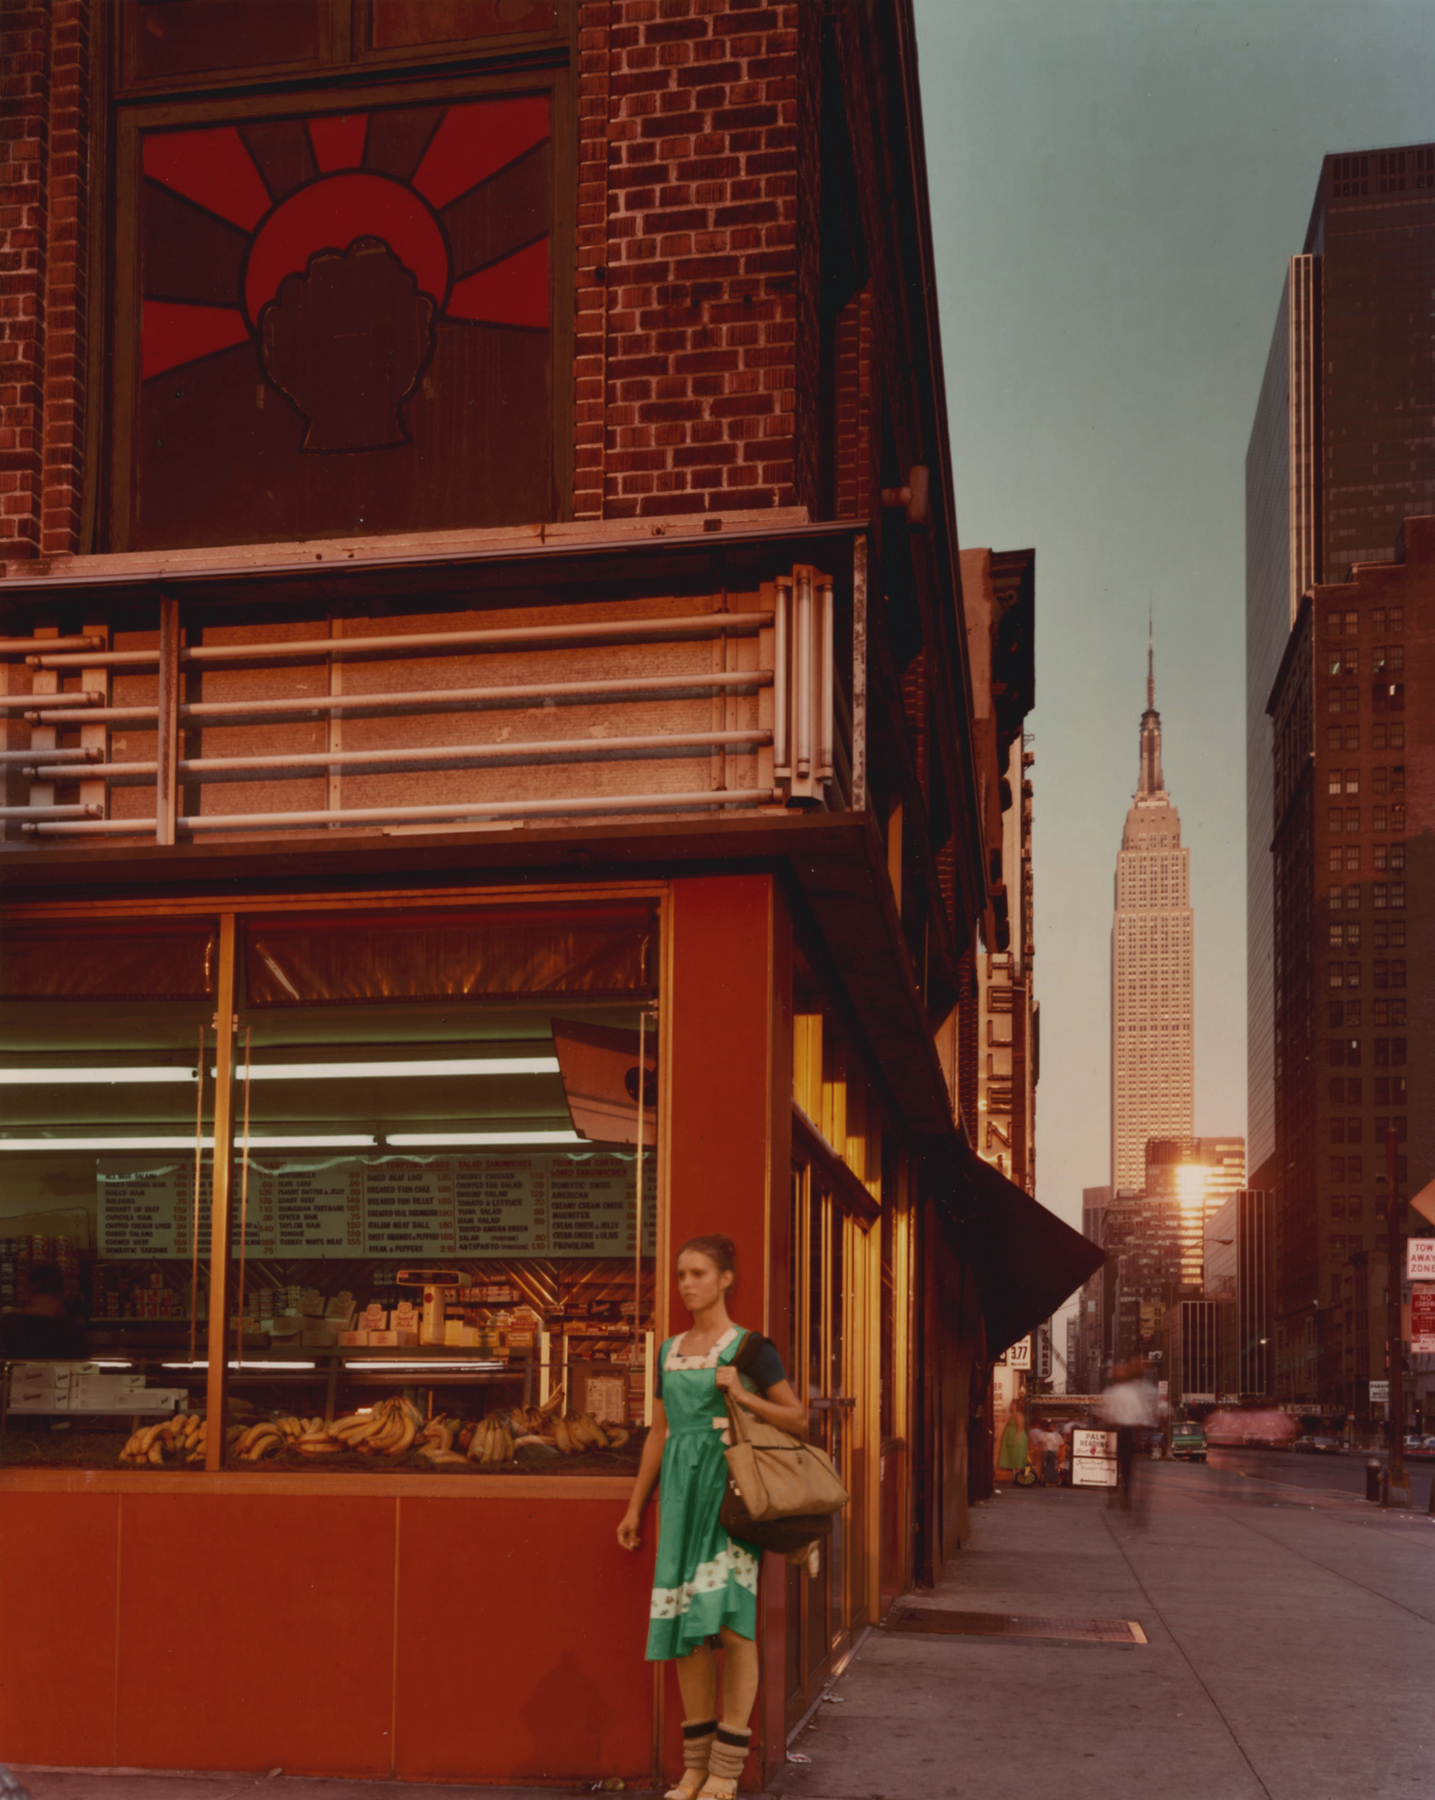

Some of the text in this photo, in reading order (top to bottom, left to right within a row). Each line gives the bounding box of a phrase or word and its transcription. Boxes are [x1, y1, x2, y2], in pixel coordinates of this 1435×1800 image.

[458, 1160, 531, 1168] SALAD SANDWICHES
[367, 1197, 395, 1205] BREADED
[397, 1197, 411, 1205] FISH
[412, 1197, 434, 1205] FILLET
[1415, 1244, 1434, 1252] TOW
[1411, 1254, 1435, 1262] AWAY
[1411, 1264, 1435, 1273] ZONE
[1011, 1346, 1028, 1360] 3.77
[1041, 1329, 1049, 1375] YORKER
[1080, 1440, 1110, 1448] READING
